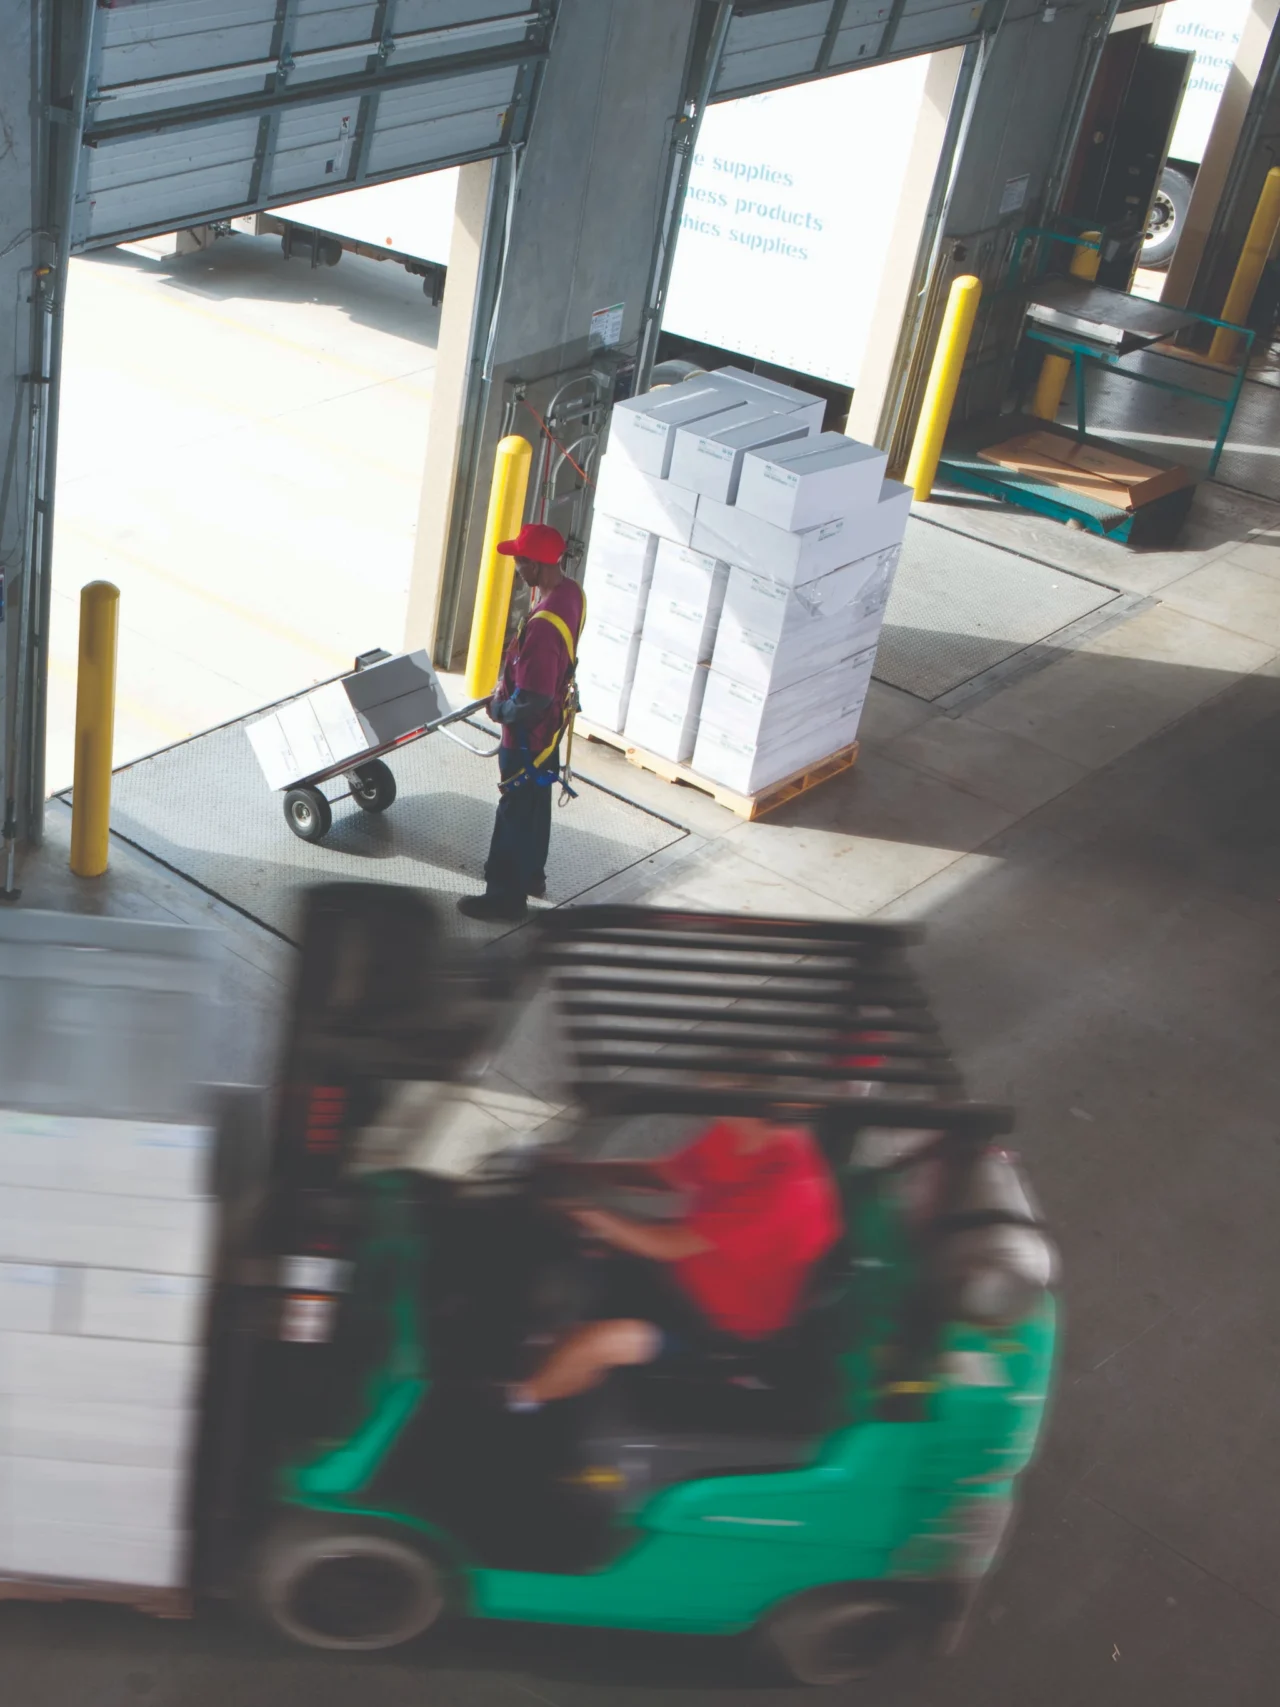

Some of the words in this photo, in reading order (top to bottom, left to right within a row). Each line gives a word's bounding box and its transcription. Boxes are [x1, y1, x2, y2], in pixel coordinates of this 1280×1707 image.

[1175, 22, 1225, 41] office
[712, 156, 795, 187] supplies
[734, 198, 824, 232] products
[728, 227, 809, 260] supplies
